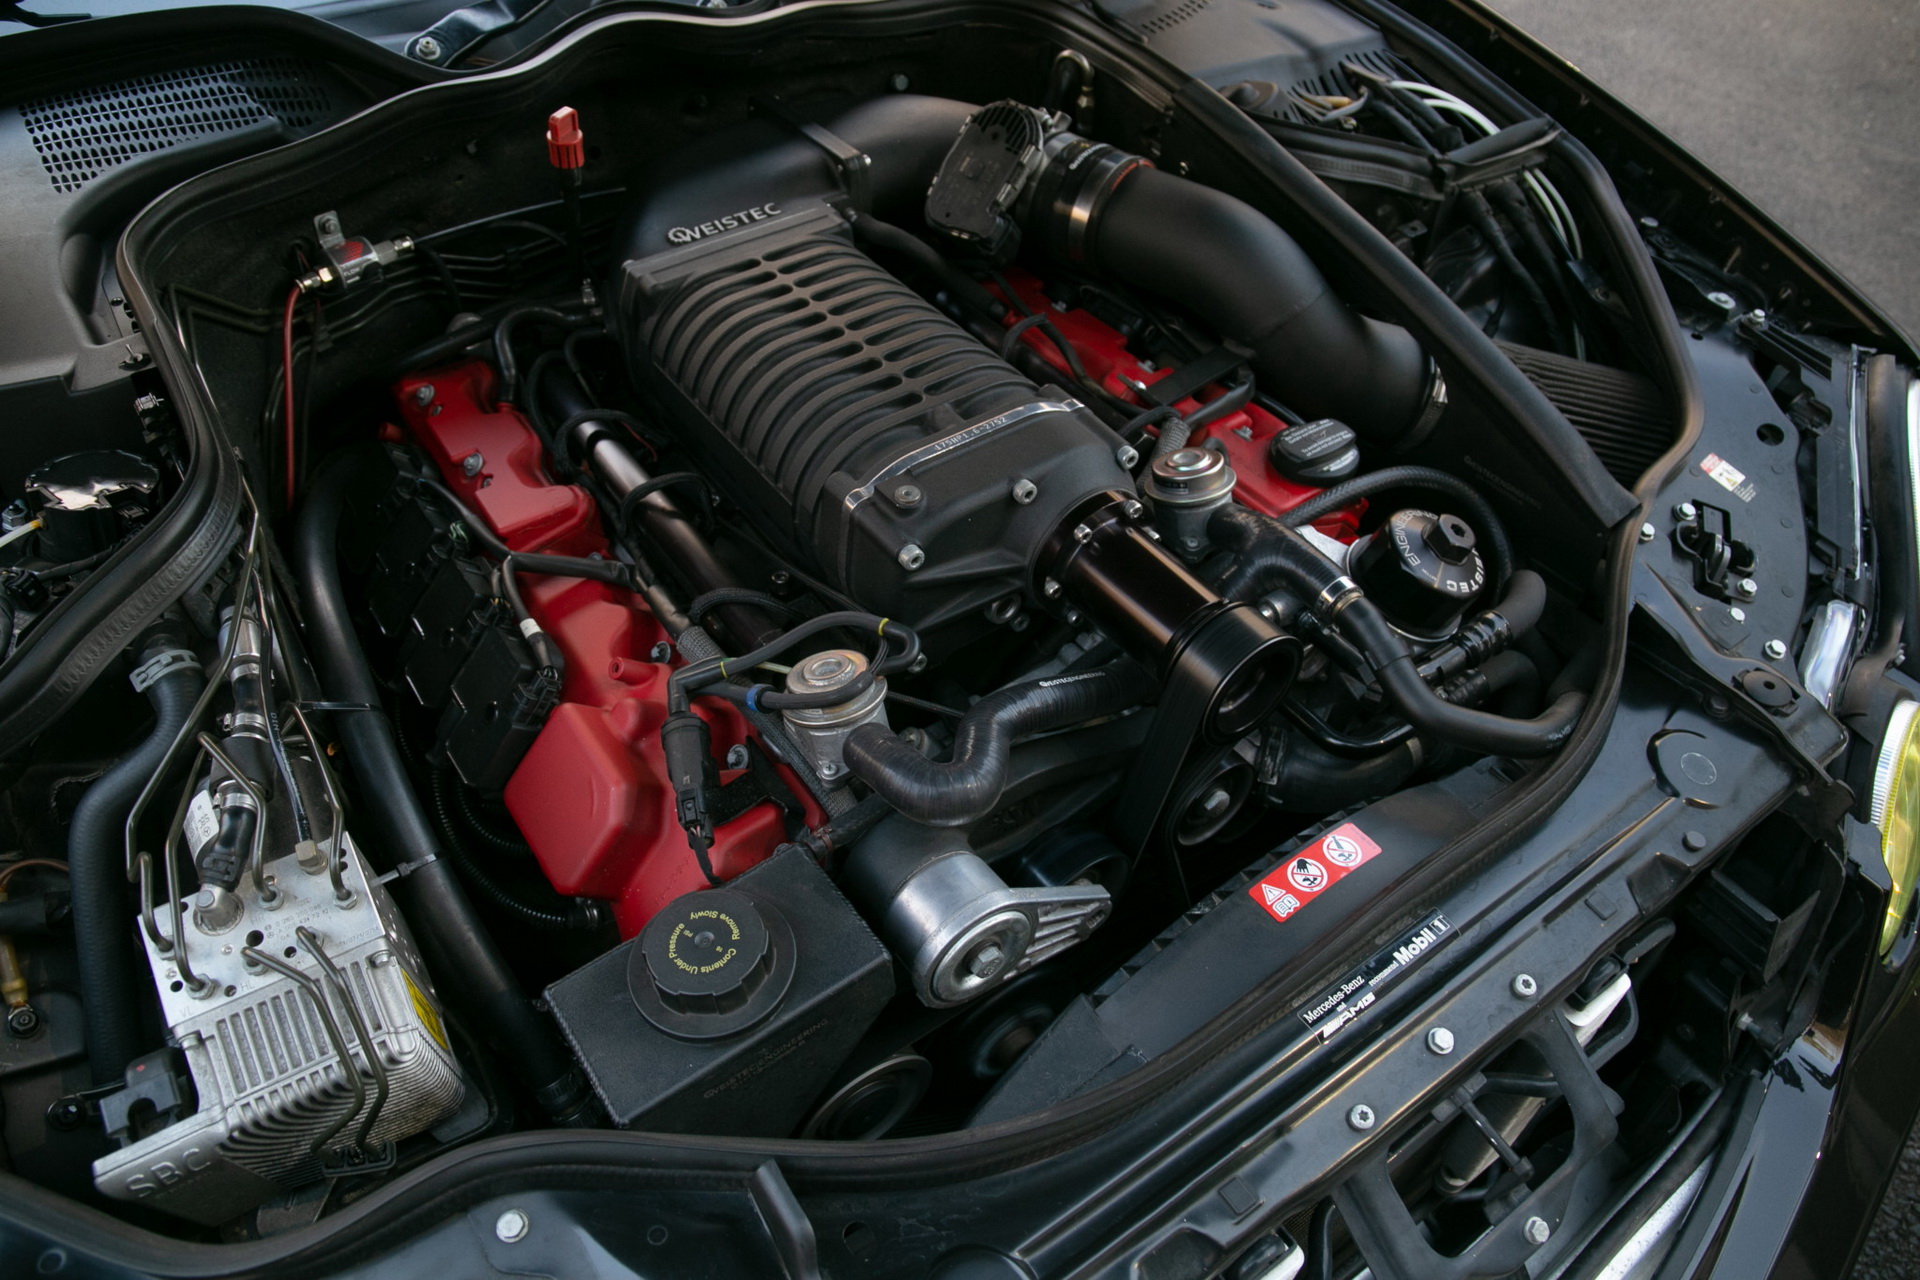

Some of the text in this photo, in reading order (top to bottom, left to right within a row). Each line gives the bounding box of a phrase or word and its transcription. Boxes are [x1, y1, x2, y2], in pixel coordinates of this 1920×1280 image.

[668, 923, 737, 975] Contents Under Pressure
[690, 910, 740, 941] Remove Slowly
[1368, 960, 1400, 987] recommend
[1392, 927, 1438, 966] Mobil
[1303, 975, 1365, 1024] Mercedes-Benz
[126, 1148, 211, 1198] SBC
